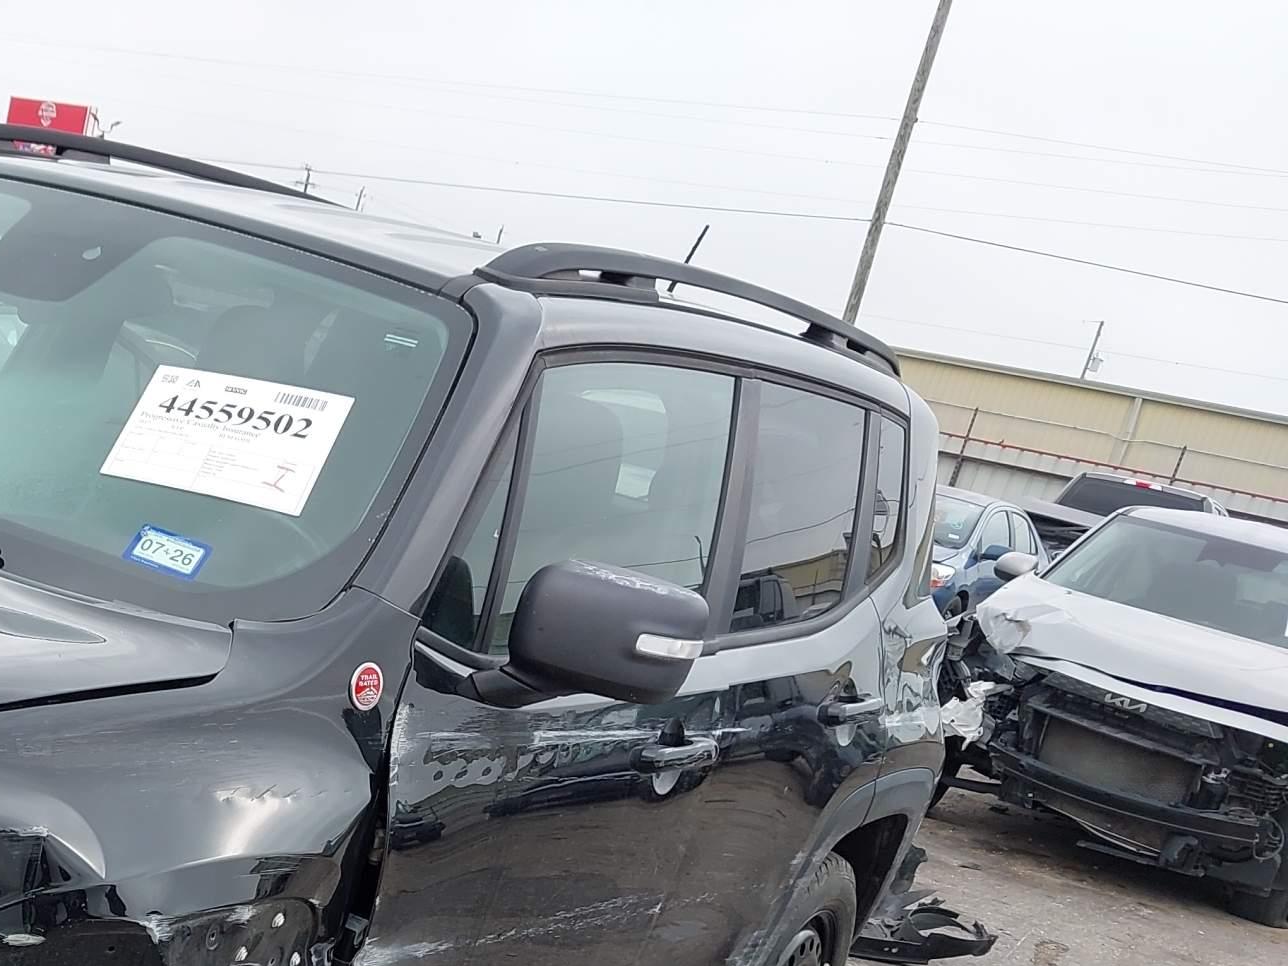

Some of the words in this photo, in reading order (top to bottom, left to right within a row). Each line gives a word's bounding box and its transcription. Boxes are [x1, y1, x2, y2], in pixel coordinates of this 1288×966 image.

[158, 394, 313, 439] 44559502
[140, 538, 165, 554] 07
[169, 549, 195, 566] 26
